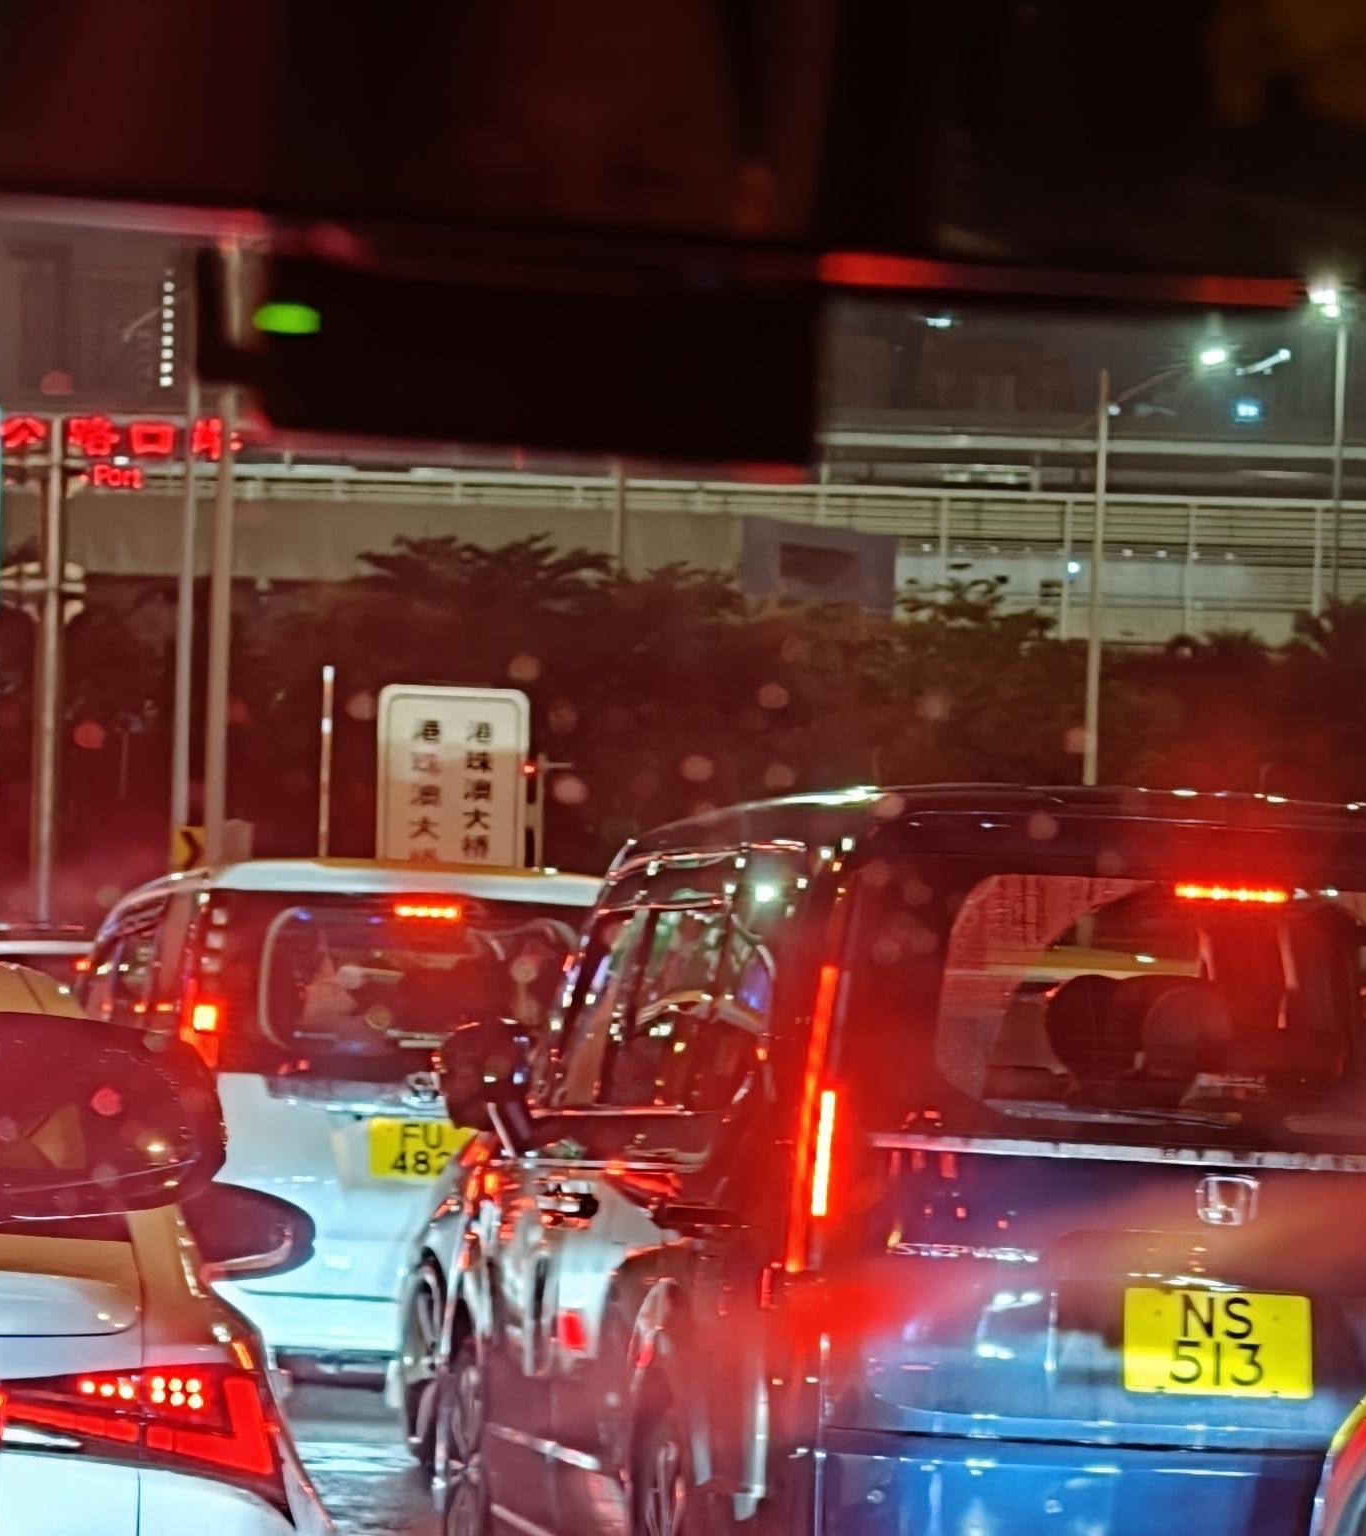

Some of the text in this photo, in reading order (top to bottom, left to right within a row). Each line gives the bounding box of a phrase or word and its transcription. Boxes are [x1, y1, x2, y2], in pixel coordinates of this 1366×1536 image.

[401, 1123, 443, 1149] FU
[1180, 1294, 1254, 1340] NS
[1168, 1340, 1265, 1387] 513
